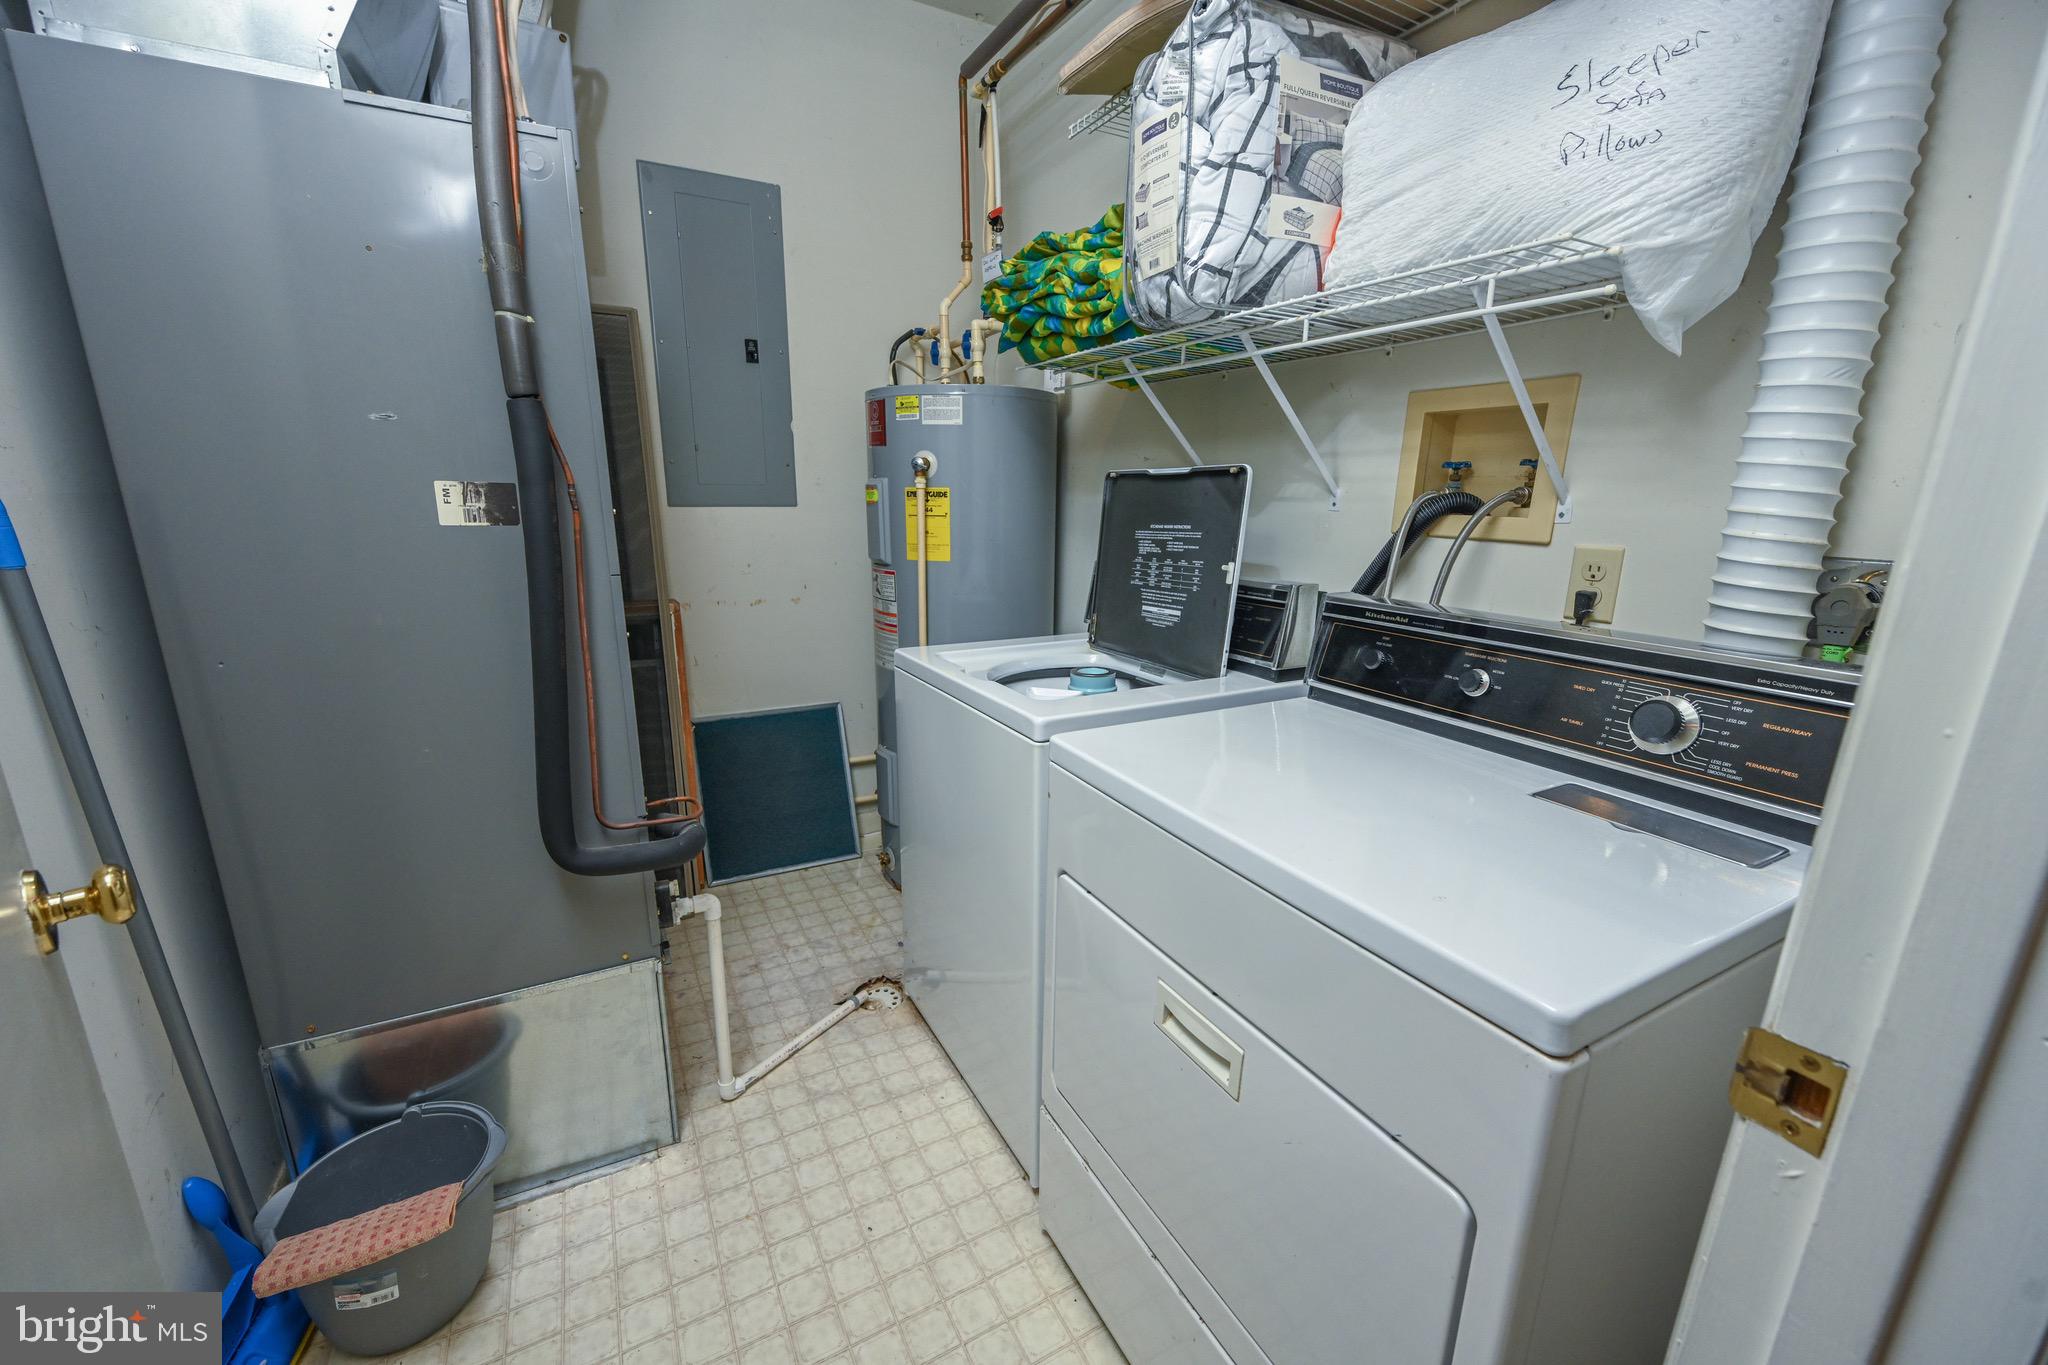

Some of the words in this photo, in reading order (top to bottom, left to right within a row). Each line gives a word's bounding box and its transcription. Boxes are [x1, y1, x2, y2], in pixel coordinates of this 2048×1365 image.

[1551, 30, 1710, 110] Sleeper
[1283, 83, 1319, 100] FULL/QUEEN
[1320, 94, 1351, 108] REVERSIBLE
[1559, 124, 1663, 166] Pillows
[1365, 610, 1409, 624] KitchenAid
[1772, 680, 1819, 693] Capacity/Heavy
[1762, 722, 1813, 737] REGULAR/HEAVY
[1745, 761, 1780, 774] PERMANENT
[1781, 769, 1799, 779] PRESS
